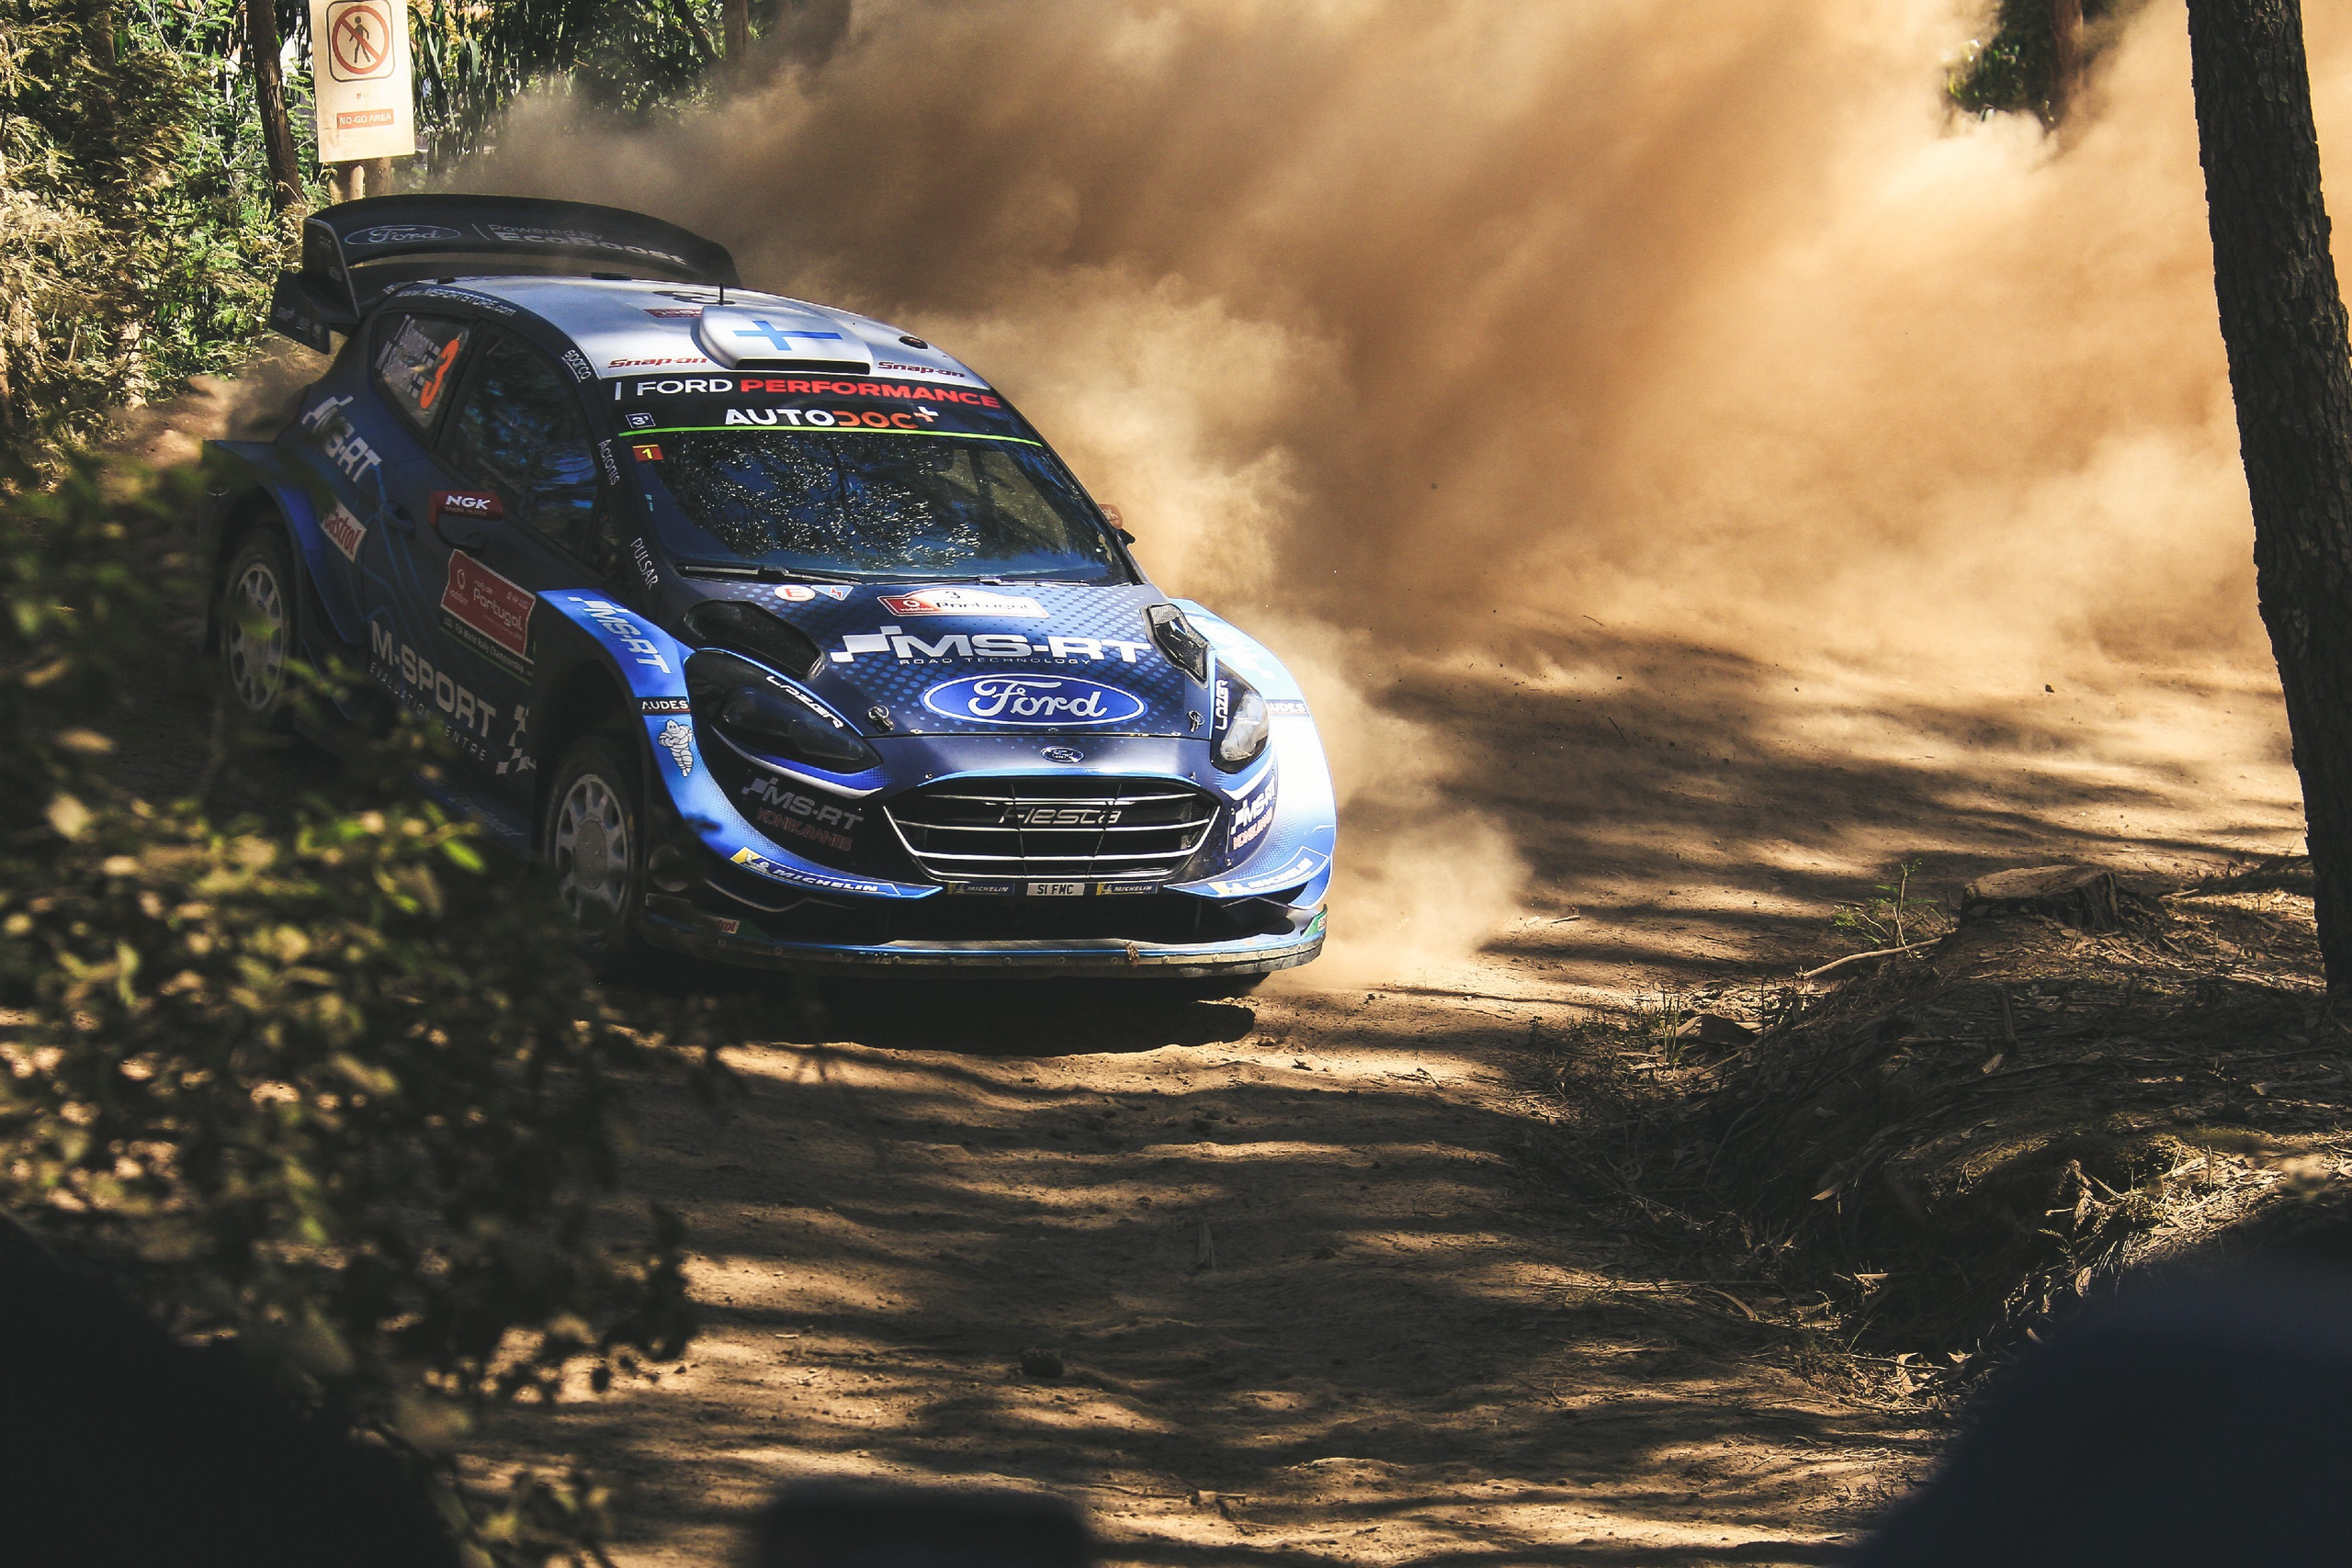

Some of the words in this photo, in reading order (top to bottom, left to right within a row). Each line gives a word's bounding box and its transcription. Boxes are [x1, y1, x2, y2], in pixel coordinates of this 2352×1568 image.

[339, 115, 368, 126] NO-GO
[368, 112, 392, 122] AREA
[368, 228, 440, 243] Ford
[488, 224, 575, 237] Powered
[582, 231, 602, 241] by
[494, 231, 687, 265] EcoBoost
[564, 349, 592, 380] sparco
[607, 357, 707, 368] Snap-on
[877, 361, 966, 378] Snap-on
[637, 378, 733, 396] FORD
[741, 379, 1001, 409] PERFORMANCE
[311, 406, 382, 482] S-RT
[641, 447, 653, 459] 1
[598, 438, 620, 486] Acronis
[446, 494, 491, 510] NGK
[631, 537, 660, 592] PULSAR
[944, 591, 961, 599] 3
[473, 588, 523, 631] Portugal
[890, 634, 1152, 662] MS-RT
[967, 679, 1108, 717] Ford
[438, 720, 487, 761] ENTRE
[762, 785, 865, 830] MS-RT
[756, 807, 853, 852] KONECRANES
[774, 868, 878, 892] MICHELIN
[1248, 856, 1314, 889] MICHELIN
[967, 885, 1009, 893] MICHELIN
[1051, 885, 1074, 896] FMC
[1114, 885, 1153, 893] MICHELIN
